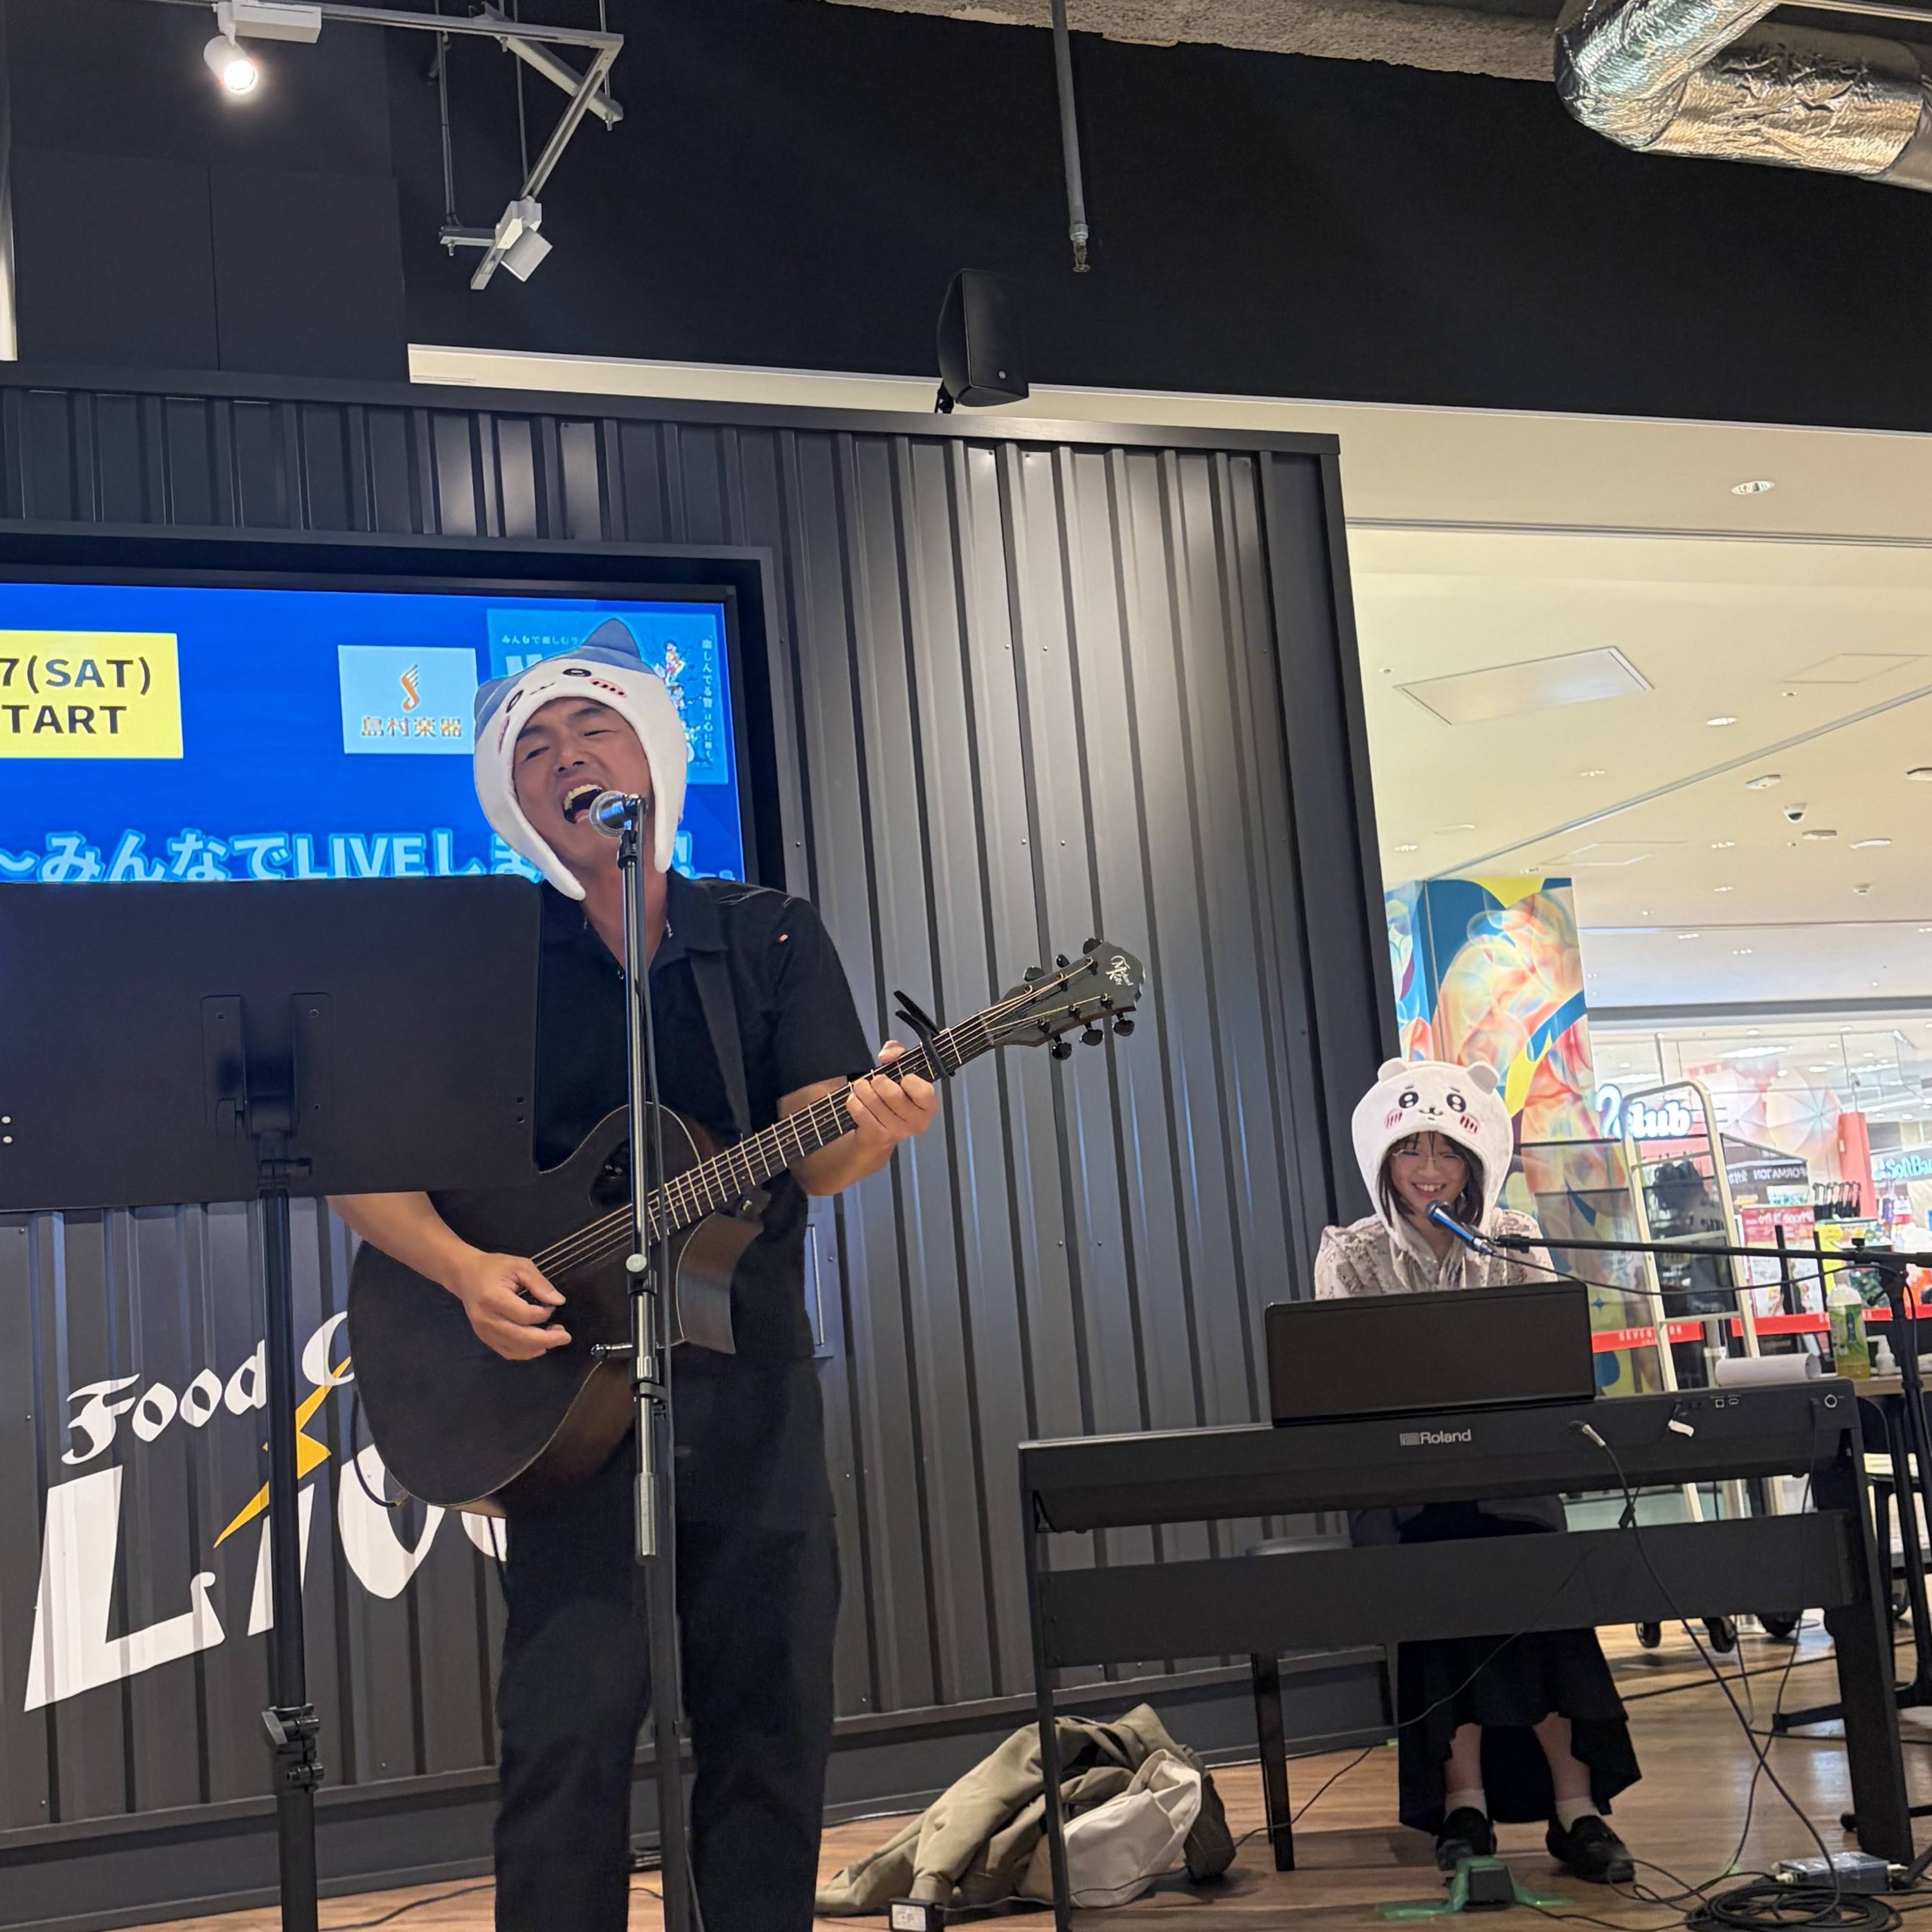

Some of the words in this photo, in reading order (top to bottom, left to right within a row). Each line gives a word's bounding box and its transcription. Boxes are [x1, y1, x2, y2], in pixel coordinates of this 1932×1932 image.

[0, 655, 152, 696] 7(SAT)
[361, 717, 462, 737] 島村楽器
[61, 1338, 266, 1465] Food
[1420, 1429, 1472, 1444] Roland
